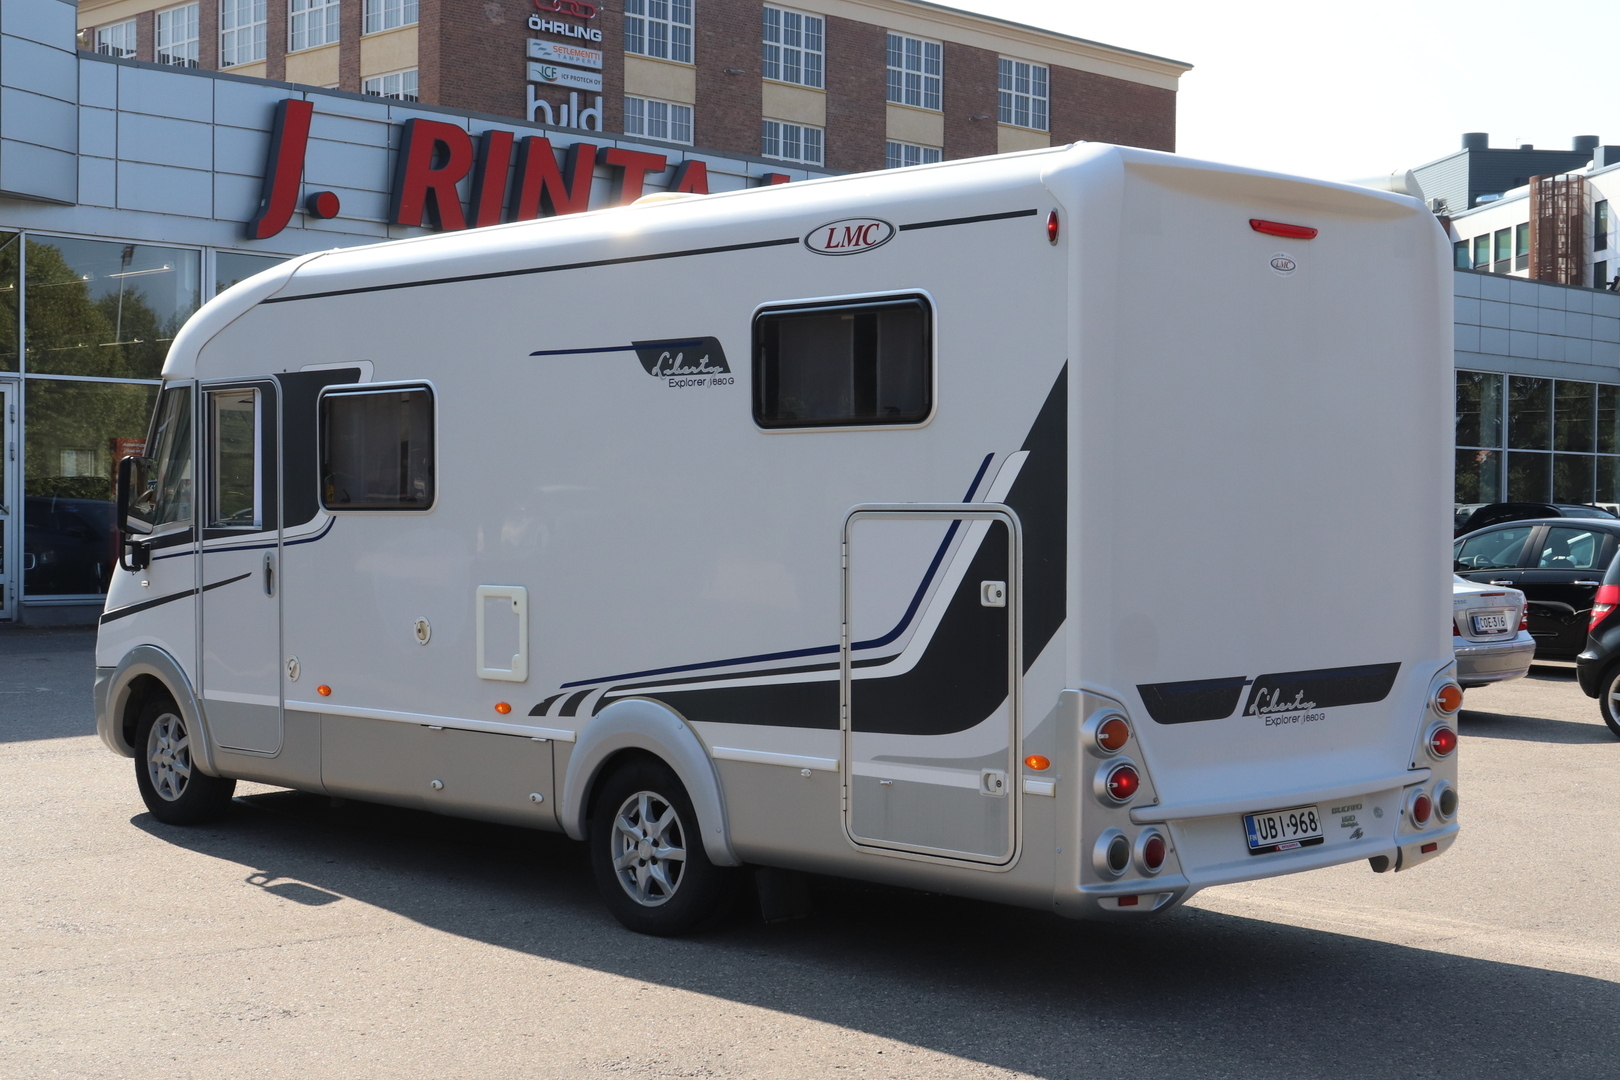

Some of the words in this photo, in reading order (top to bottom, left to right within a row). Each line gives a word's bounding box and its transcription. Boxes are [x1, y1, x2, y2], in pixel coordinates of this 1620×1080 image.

[528, 14, 602, 42] ÖHRLING
[553, 45, 600, 60] SETLEMENTTI
[557, 54, 597, 65] TAMPERE
[541, 66, 557, 78] ICF
[570, 74, 593, 84] PROTECH
[249, 98, 340, 240] J.
[825, 222, 880, 249] LMC
[652, 351, 723, 387] Liberty
[669, 378, 707, 389] Explorer
[1480, 616, 1505, 628] COE-316
[1249, 687, 1317, 725] Liberty
[1265, 715, 1301, 727] Explorer
[1257, 811, 1318, 840] UBI-968
